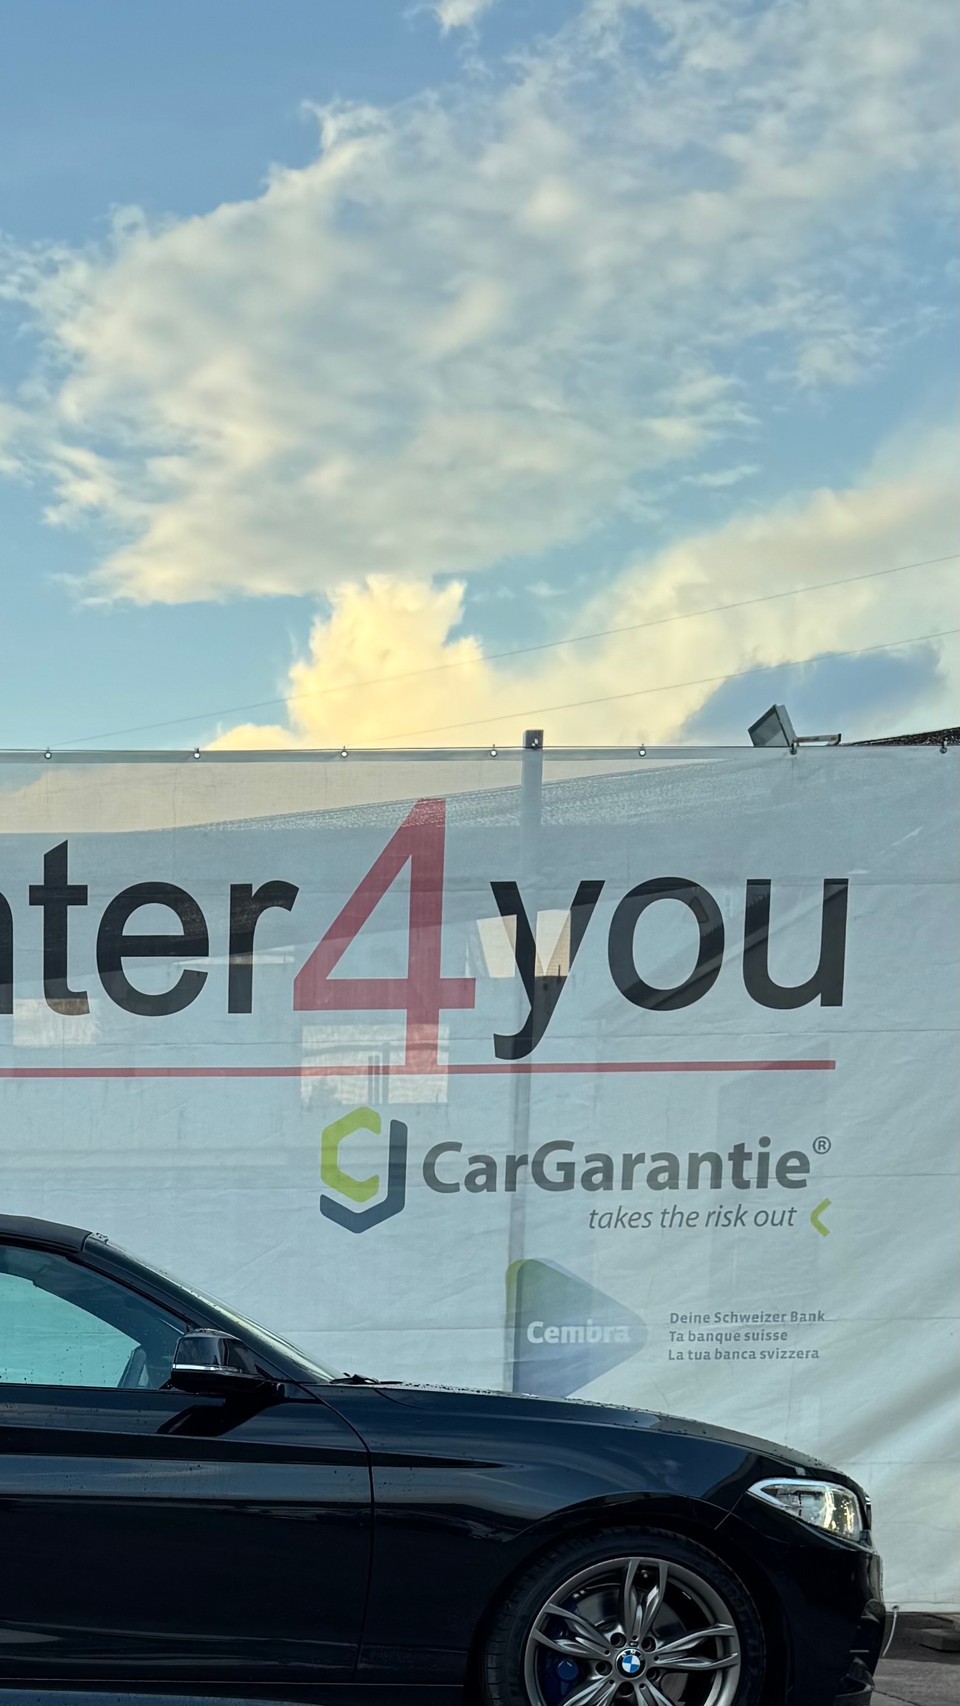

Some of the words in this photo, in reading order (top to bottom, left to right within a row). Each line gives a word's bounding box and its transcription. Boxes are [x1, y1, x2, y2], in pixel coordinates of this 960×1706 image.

[588, 1205, 652, 1229] takes
[660, 1204, 700, 1229] the
[704, 1204, 746, 1229] risk
[753, 1206, 797, 1228] out
[670, 1312, 710, 1324] Deine
[714, 1310, 787, 1323] Schweizer
[790, 1310, 825, 1323] Bank
[526, 1319, 631, 1344] Cembra
[669, 1330, 685, 1343] Ta
[688, 1329, 741, 1345] banque
[744, 1329, 788, 1342] suisse
[668, 1348, 684, 1361] La
[687, 1349, 712, 1361] tua
[714, 1348, 756, 1360] banca
[759, 1347, 819, 1360] svizzera
